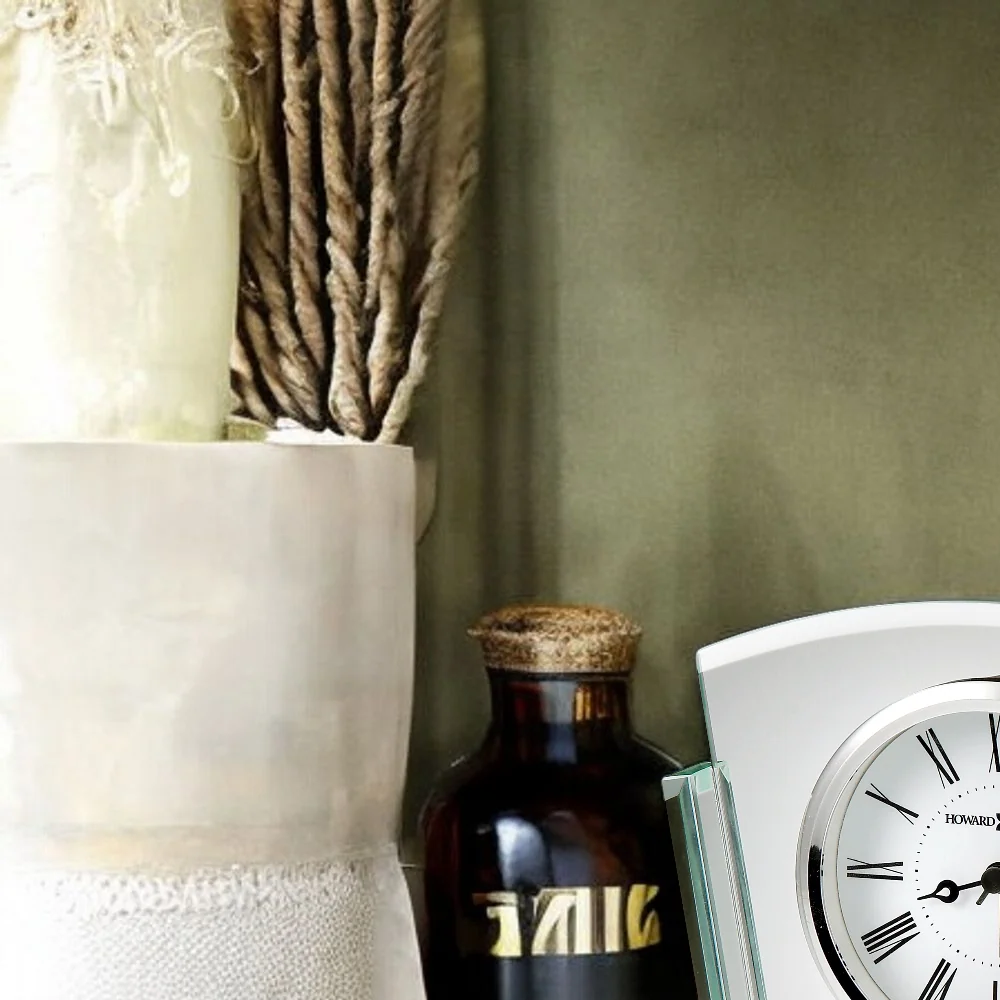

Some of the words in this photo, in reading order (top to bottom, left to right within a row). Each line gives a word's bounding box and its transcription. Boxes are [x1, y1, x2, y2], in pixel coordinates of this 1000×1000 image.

[915, 728, 961, 790] XI
[865, 783, 919, 825] X
[945, 813, 996, 827] HOWARD
[847, 857, 904, 881] IX
[861, 910, 921, 965] VIII
